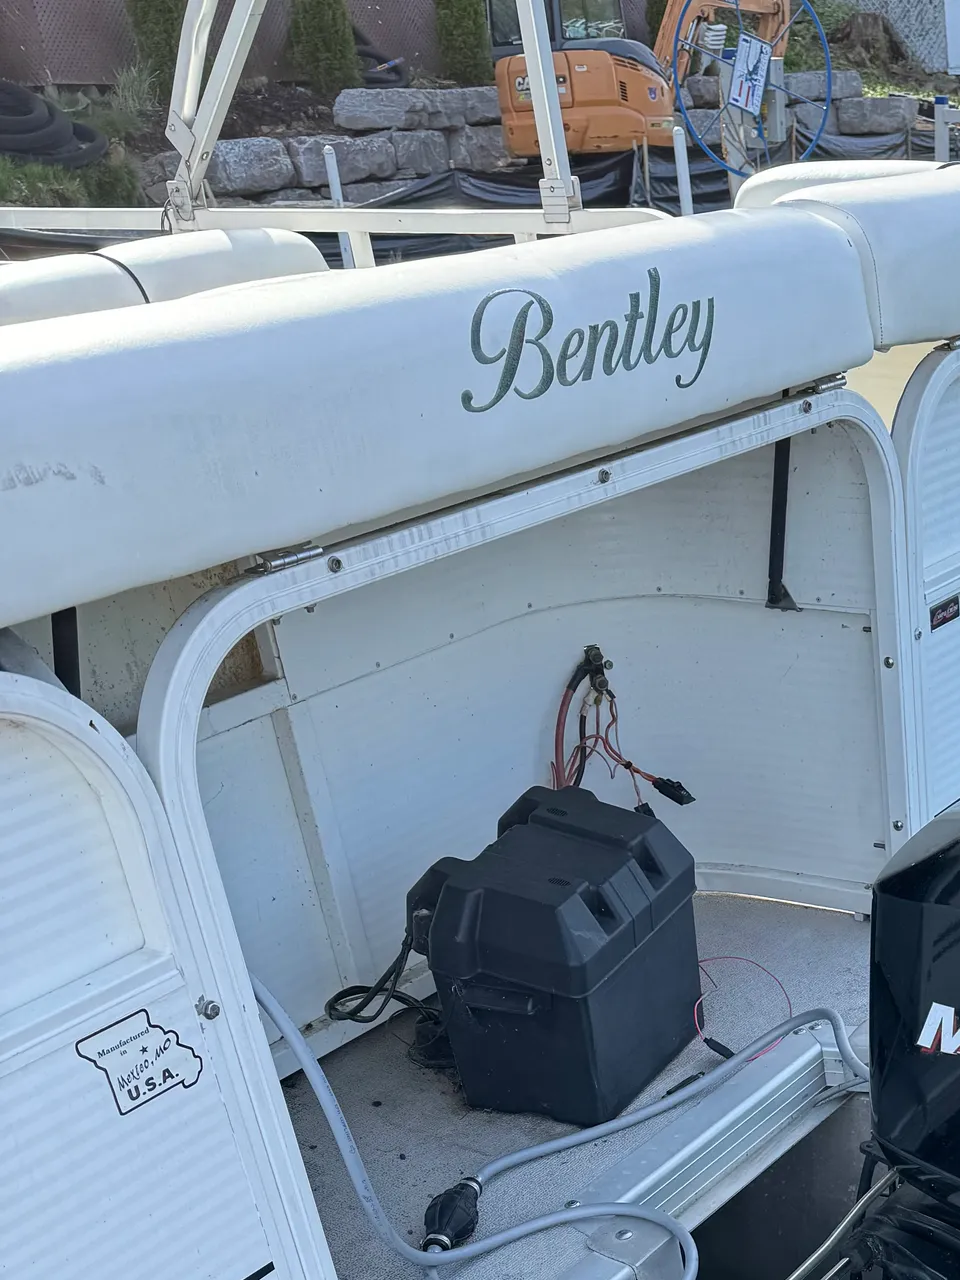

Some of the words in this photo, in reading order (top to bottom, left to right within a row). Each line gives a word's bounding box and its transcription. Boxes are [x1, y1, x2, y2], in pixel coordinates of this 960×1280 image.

[461, 267, 714, 412] Bentley
[96, 1027, 150, 1058] Manufactured
[154, 1037, 172, 1061] MO
[127, 1067, 180, 1101] U.S.A.
